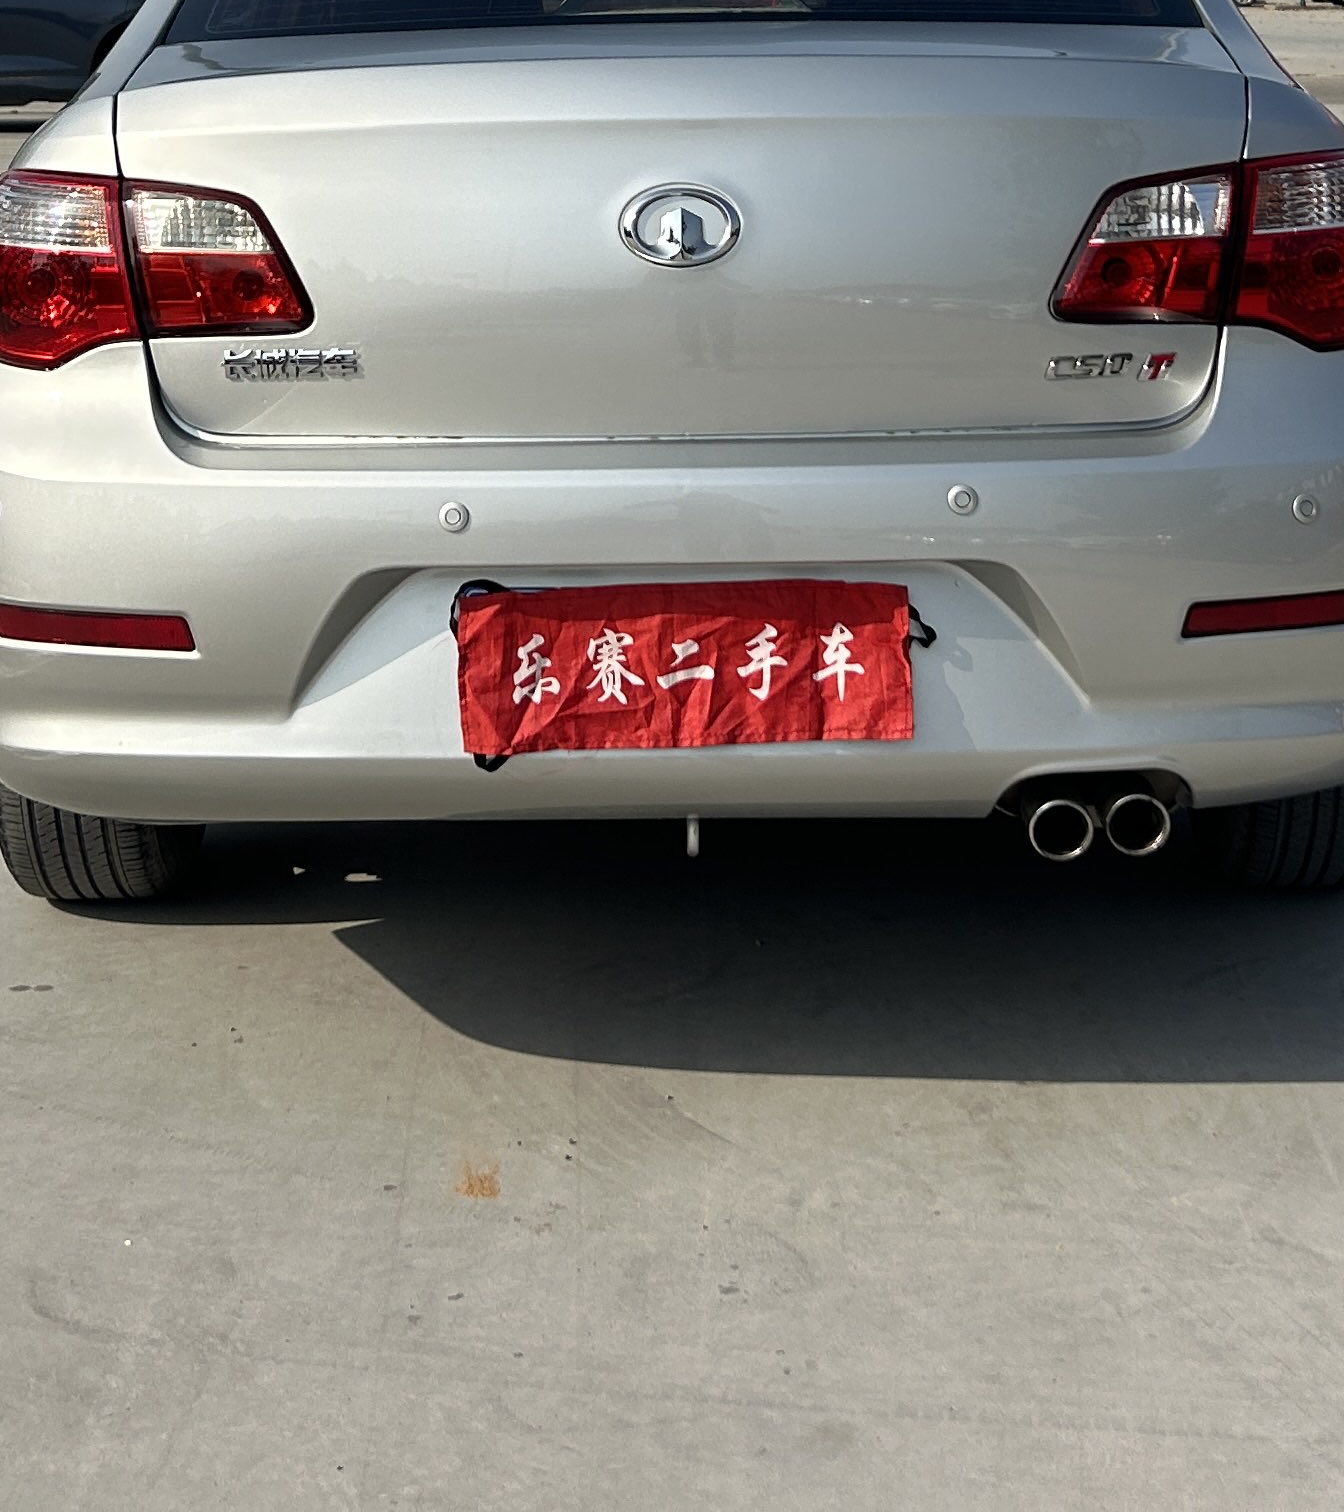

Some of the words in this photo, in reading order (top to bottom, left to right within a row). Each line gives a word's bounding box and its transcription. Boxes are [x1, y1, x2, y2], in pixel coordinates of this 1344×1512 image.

[223, 347, 358, 381] 长城汽车
[511, 621, 866, 706] 乐赛二手车
